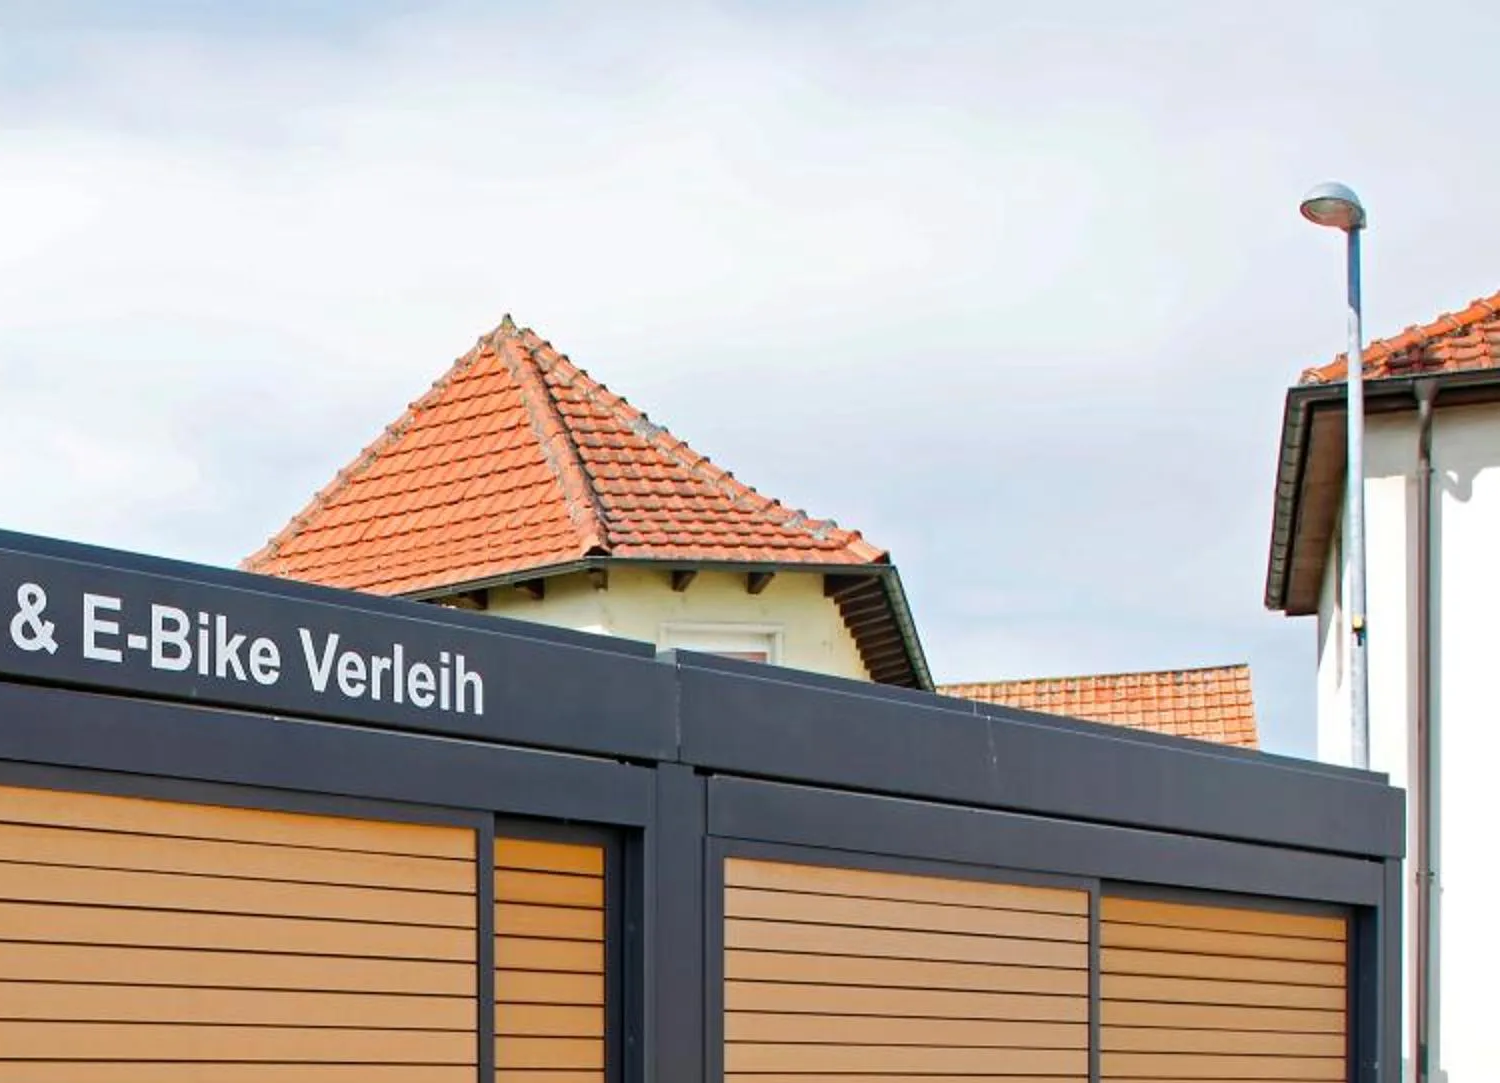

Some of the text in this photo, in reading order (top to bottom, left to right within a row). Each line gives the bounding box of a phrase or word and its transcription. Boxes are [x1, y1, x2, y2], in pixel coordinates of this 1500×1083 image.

[8, 581, 60, 656] &
[82, 591, 282, 686] E-Bike
[297, 626, 484, 716] Verleih
